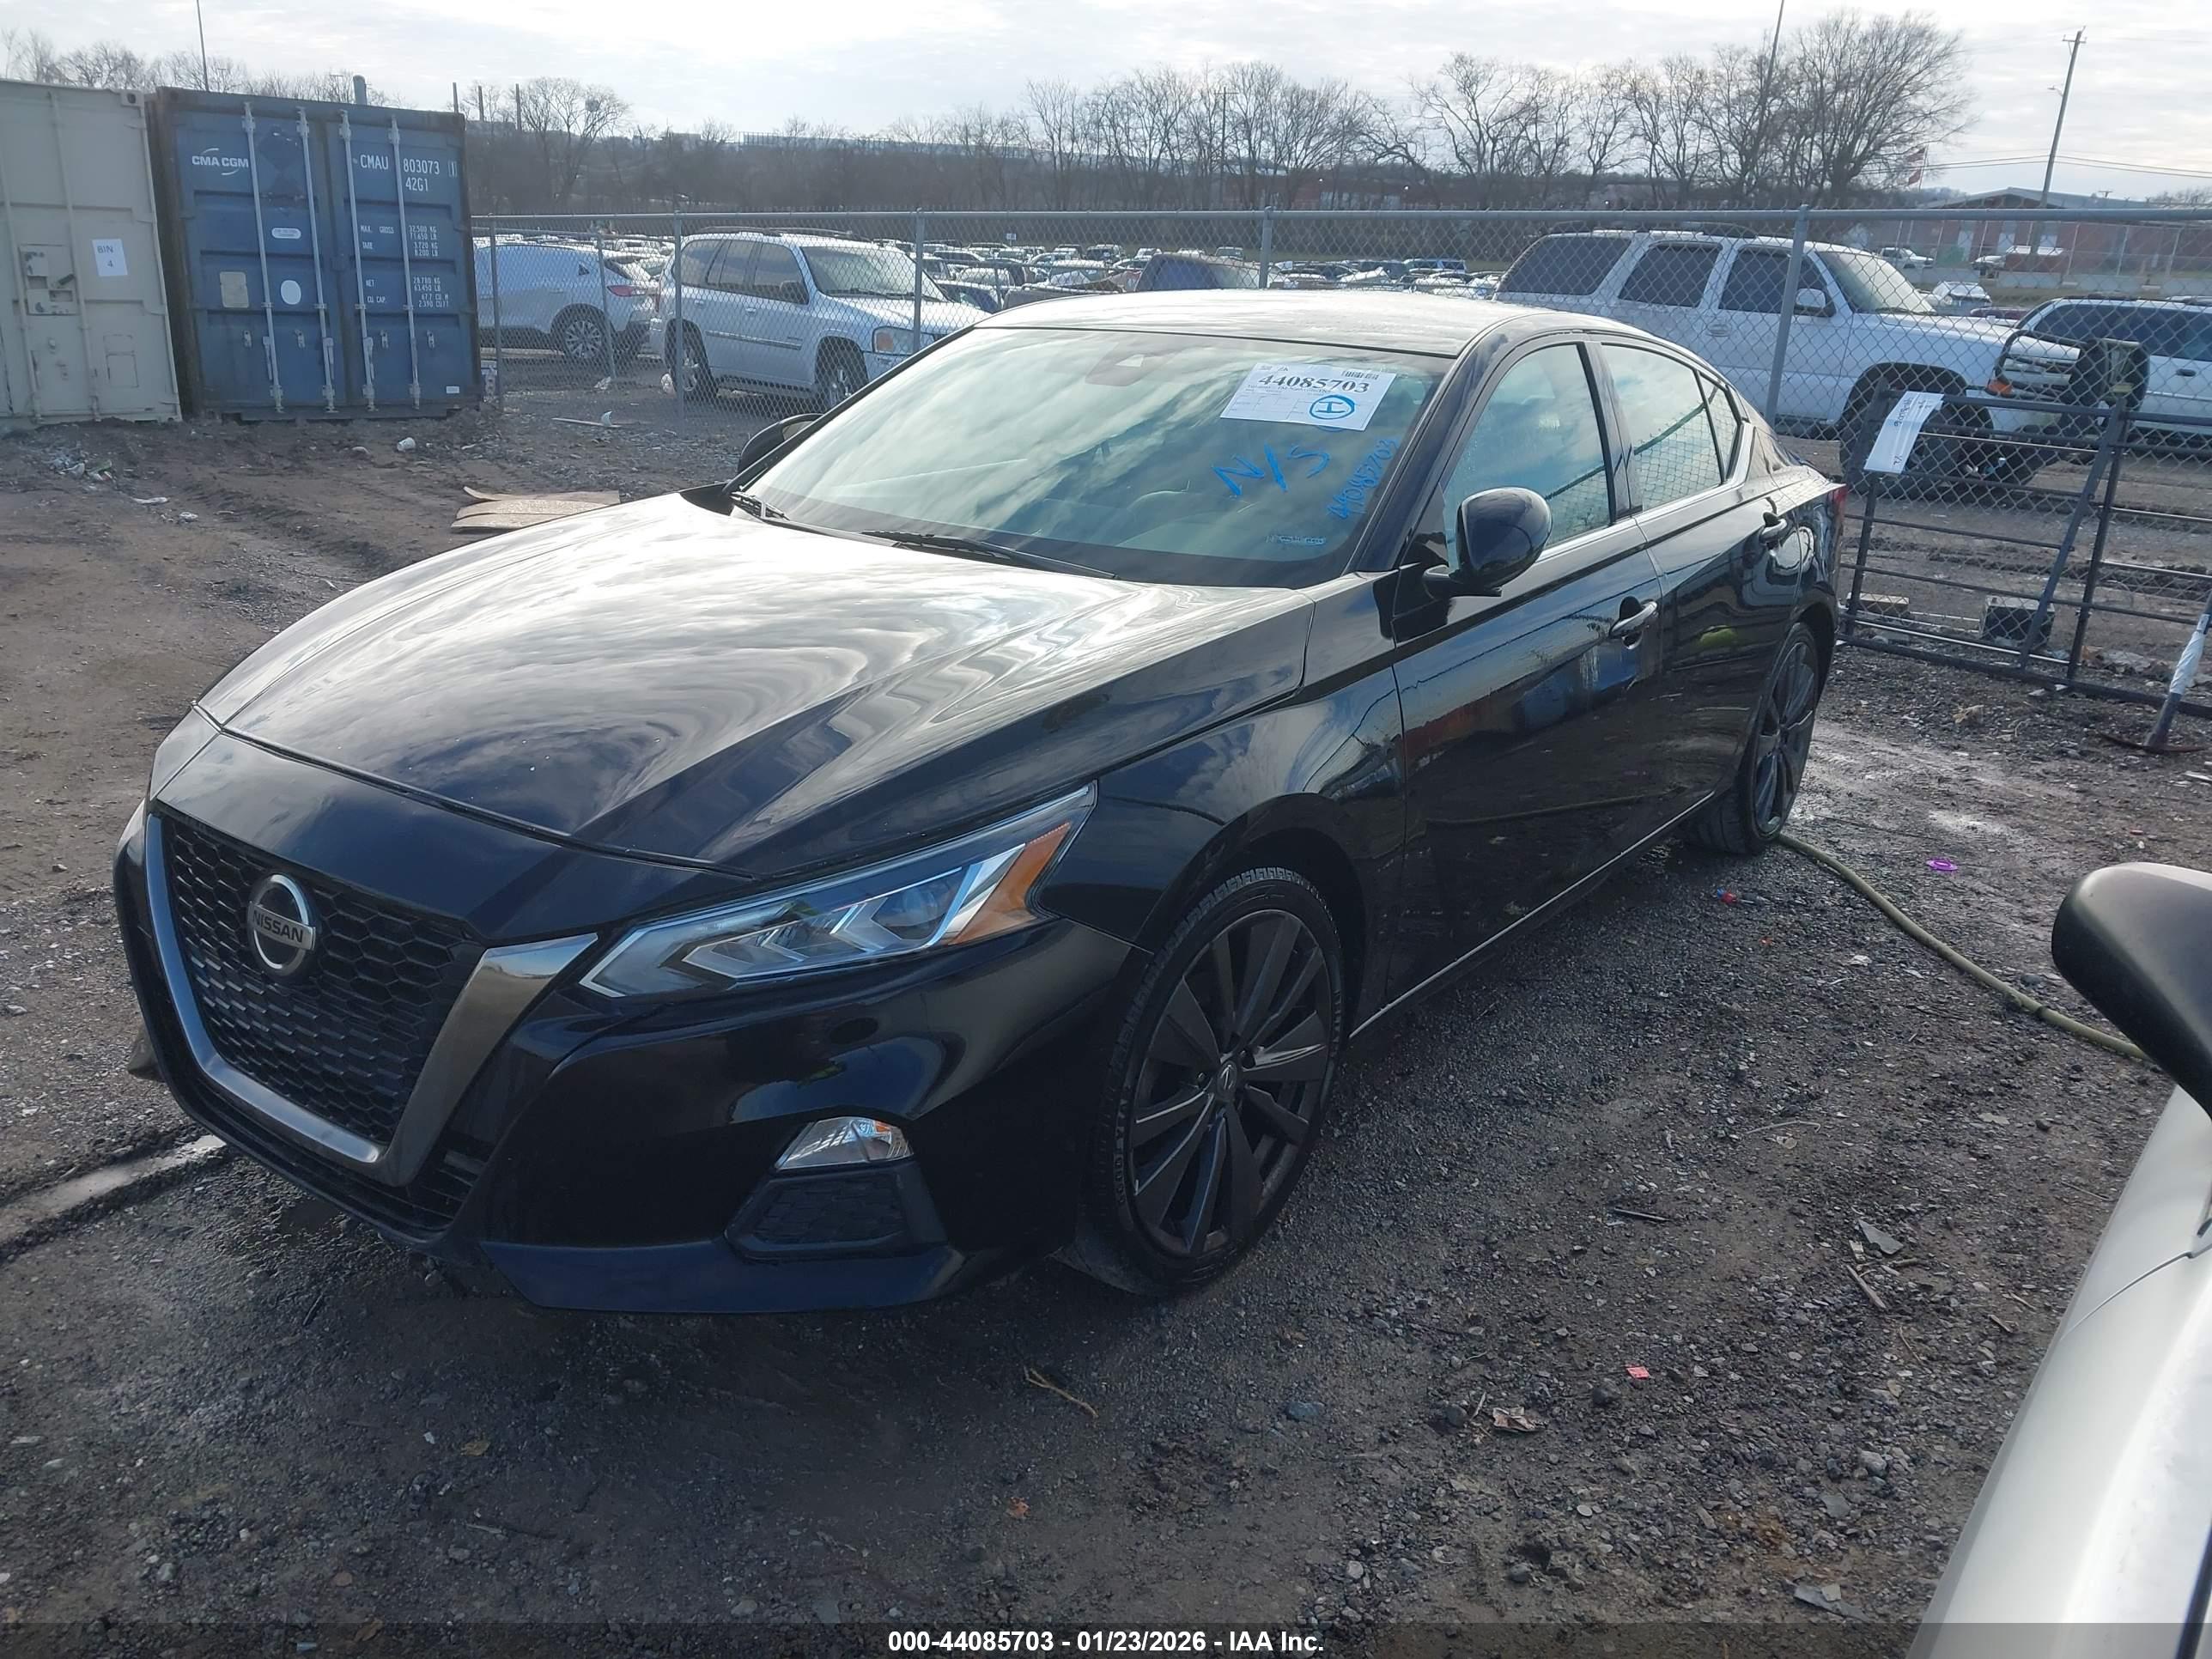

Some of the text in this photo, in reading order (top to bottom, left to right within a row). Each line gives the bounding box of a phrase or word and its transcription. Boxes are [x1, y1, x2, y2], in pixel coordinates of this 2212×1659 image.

[191, 155, 249, 168] CMA CGM
[360, 154, 389, 170] CMAU
[403, 158, 440, 175] 803073
[405, 177, 428, 192] 42G1
[96, 245, 113, 254] BIN
[1258, 374, 1370, 393] 44085703
[252, 910, 303, 944] NISSAN
